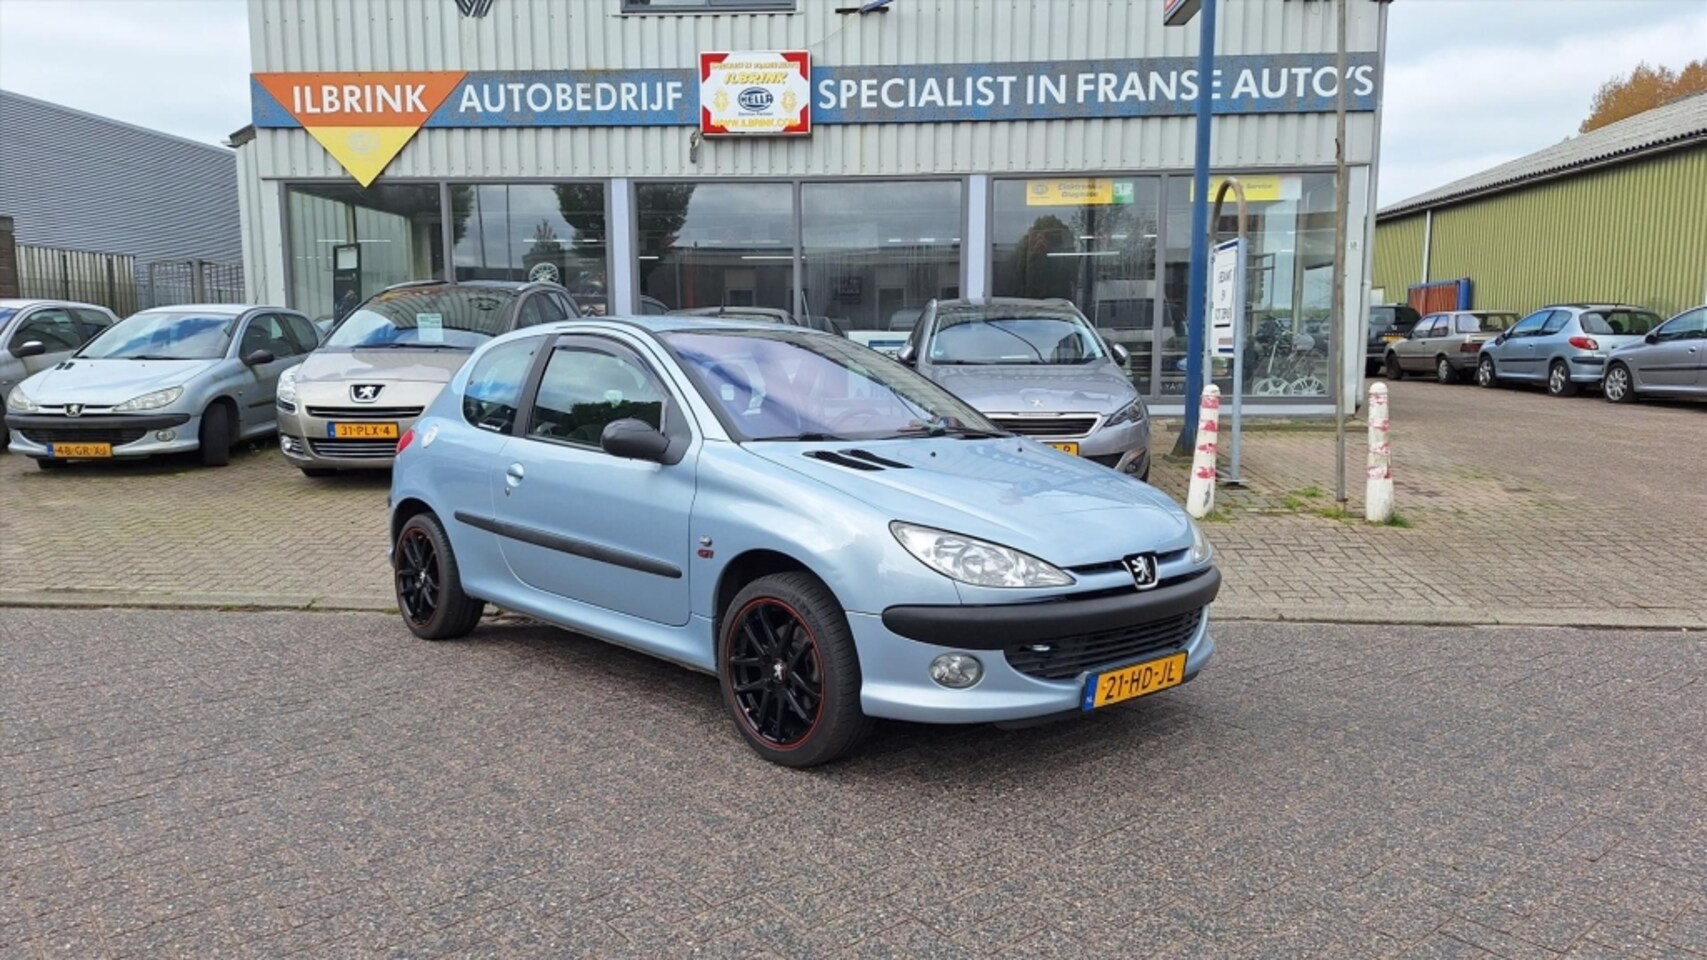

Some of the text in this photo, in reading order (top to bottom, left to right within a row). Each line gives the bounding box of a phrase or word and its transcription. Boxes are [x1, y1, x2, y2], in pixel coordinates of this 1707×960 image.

[724, 72, 788, 85] ILBRINK
[818, 75, 1017, 109] SPECIALIST
[1026, 74, 1067, 105] IN
[1230, 65, 1375, 99] AUTO'S
[293, 84, 428, 114] ILBRINK
[459, 81, 683, 113] AUTOBEDRIJF
[741, 94, 773, 104] HELLA
[341, 425, 391, 436] 31-PLX-4
